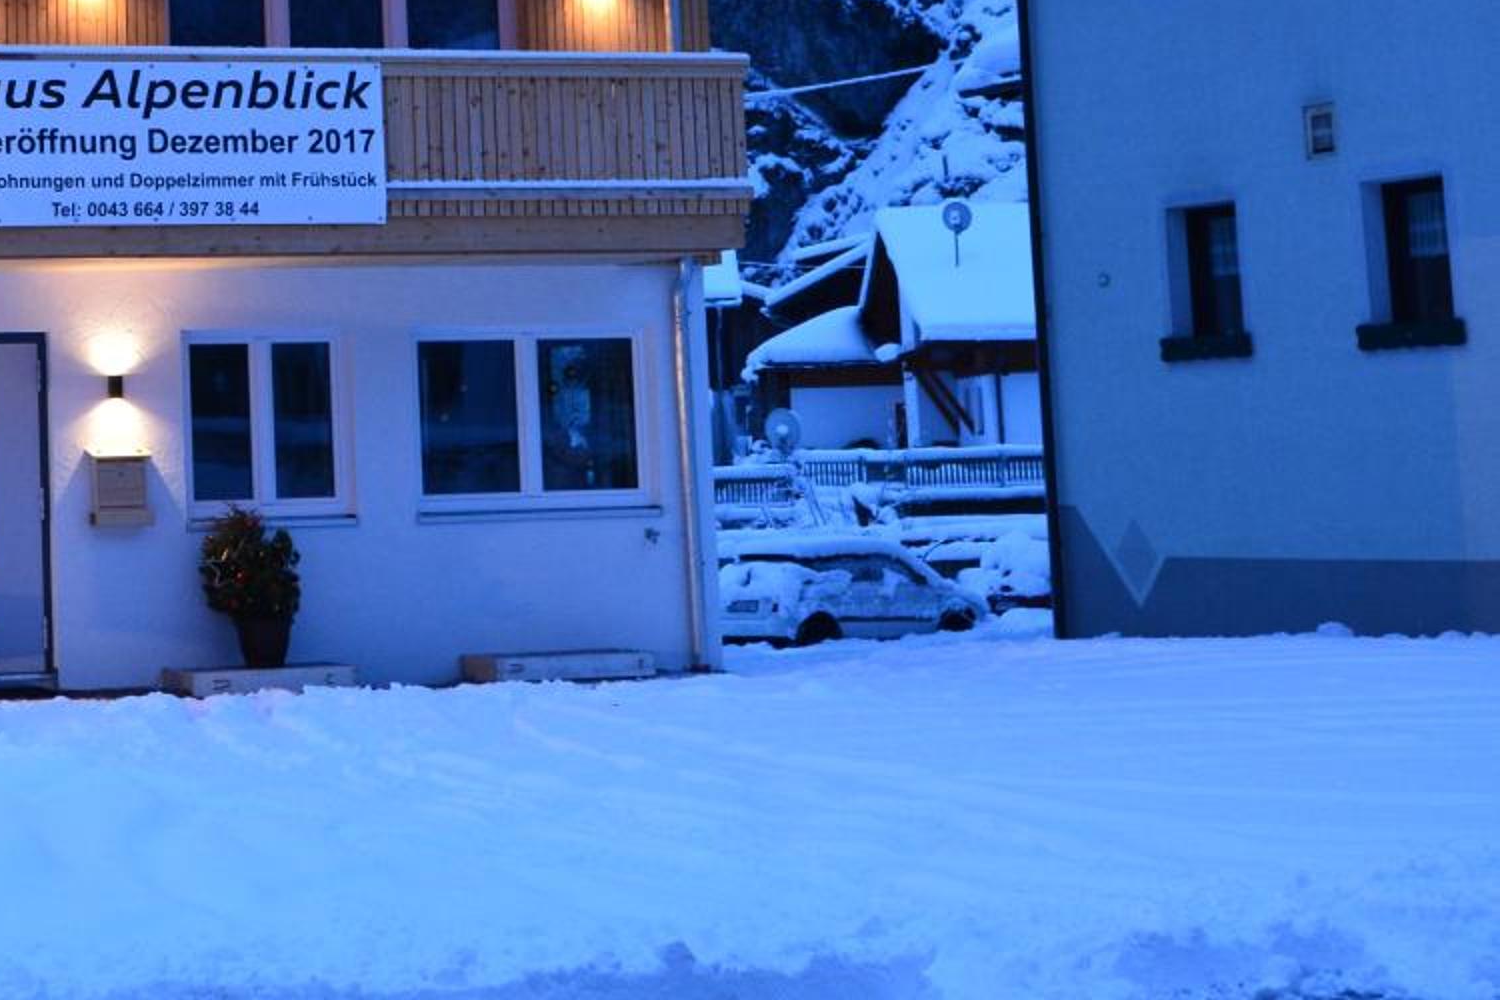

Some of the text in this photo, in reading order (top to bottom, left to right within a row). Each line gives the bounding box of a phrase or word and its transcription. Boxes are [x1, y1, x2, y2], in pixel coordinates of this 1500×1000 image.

[82, 69, 372, 119] Alpenblick
[148, 129, 299, 154] Dezember
[308, 129, 375, 153] 2017
[91, 173, 125, 188] und
[130, 172, 255, 190] Doppelzimmer
[260, 172, 287, 188] mit
[292, 172, 377, 188] Frühstück
[52, 201, 81, 217] Tel:
[87, 201, 129, 217] 0043
[134, 201, 165, 217] 664
[179, 201, 210, 217] 397
[215, 201, 235, 217] 38
[239, 201, 260, 216] 44
